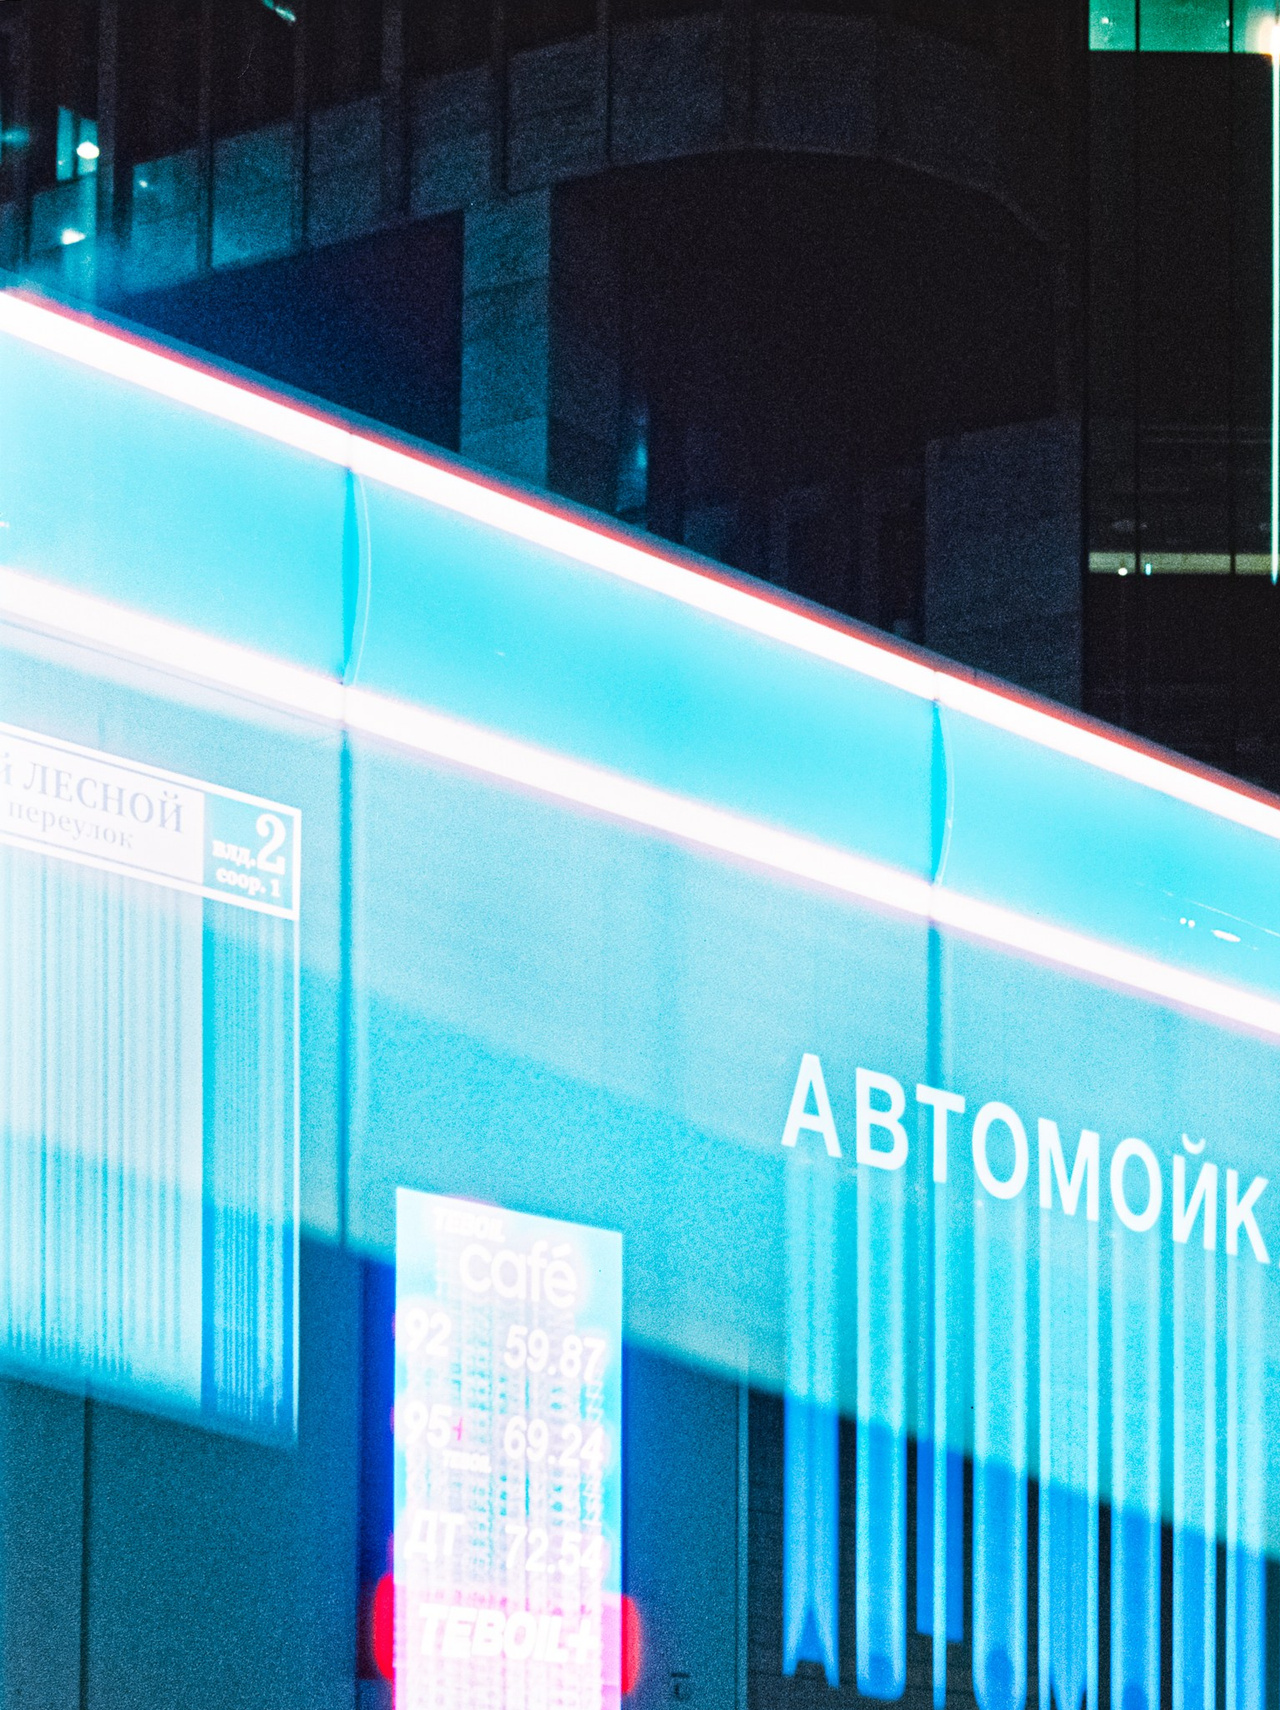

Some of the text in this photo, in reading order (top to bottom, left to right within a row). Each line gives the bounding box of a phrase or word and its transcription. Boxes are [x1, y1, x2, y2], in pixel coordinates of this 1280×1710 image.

[8, 801, 134, 850] переулок
[23, 760, 184, 833] ЛЕСНОЙ
[256, 813, 286, 875] 2
[216, 867, 282, 898] соор. 1
[433, 1206, 505, 1243] TEBOIL
[459, 1239, 578, 1309] café
[404, 1307, 606, 1384] 92 59.87
[504, 1415, 604, 1473] 69.24
[404, 1510, 604, 1577] ДТ 72.54
